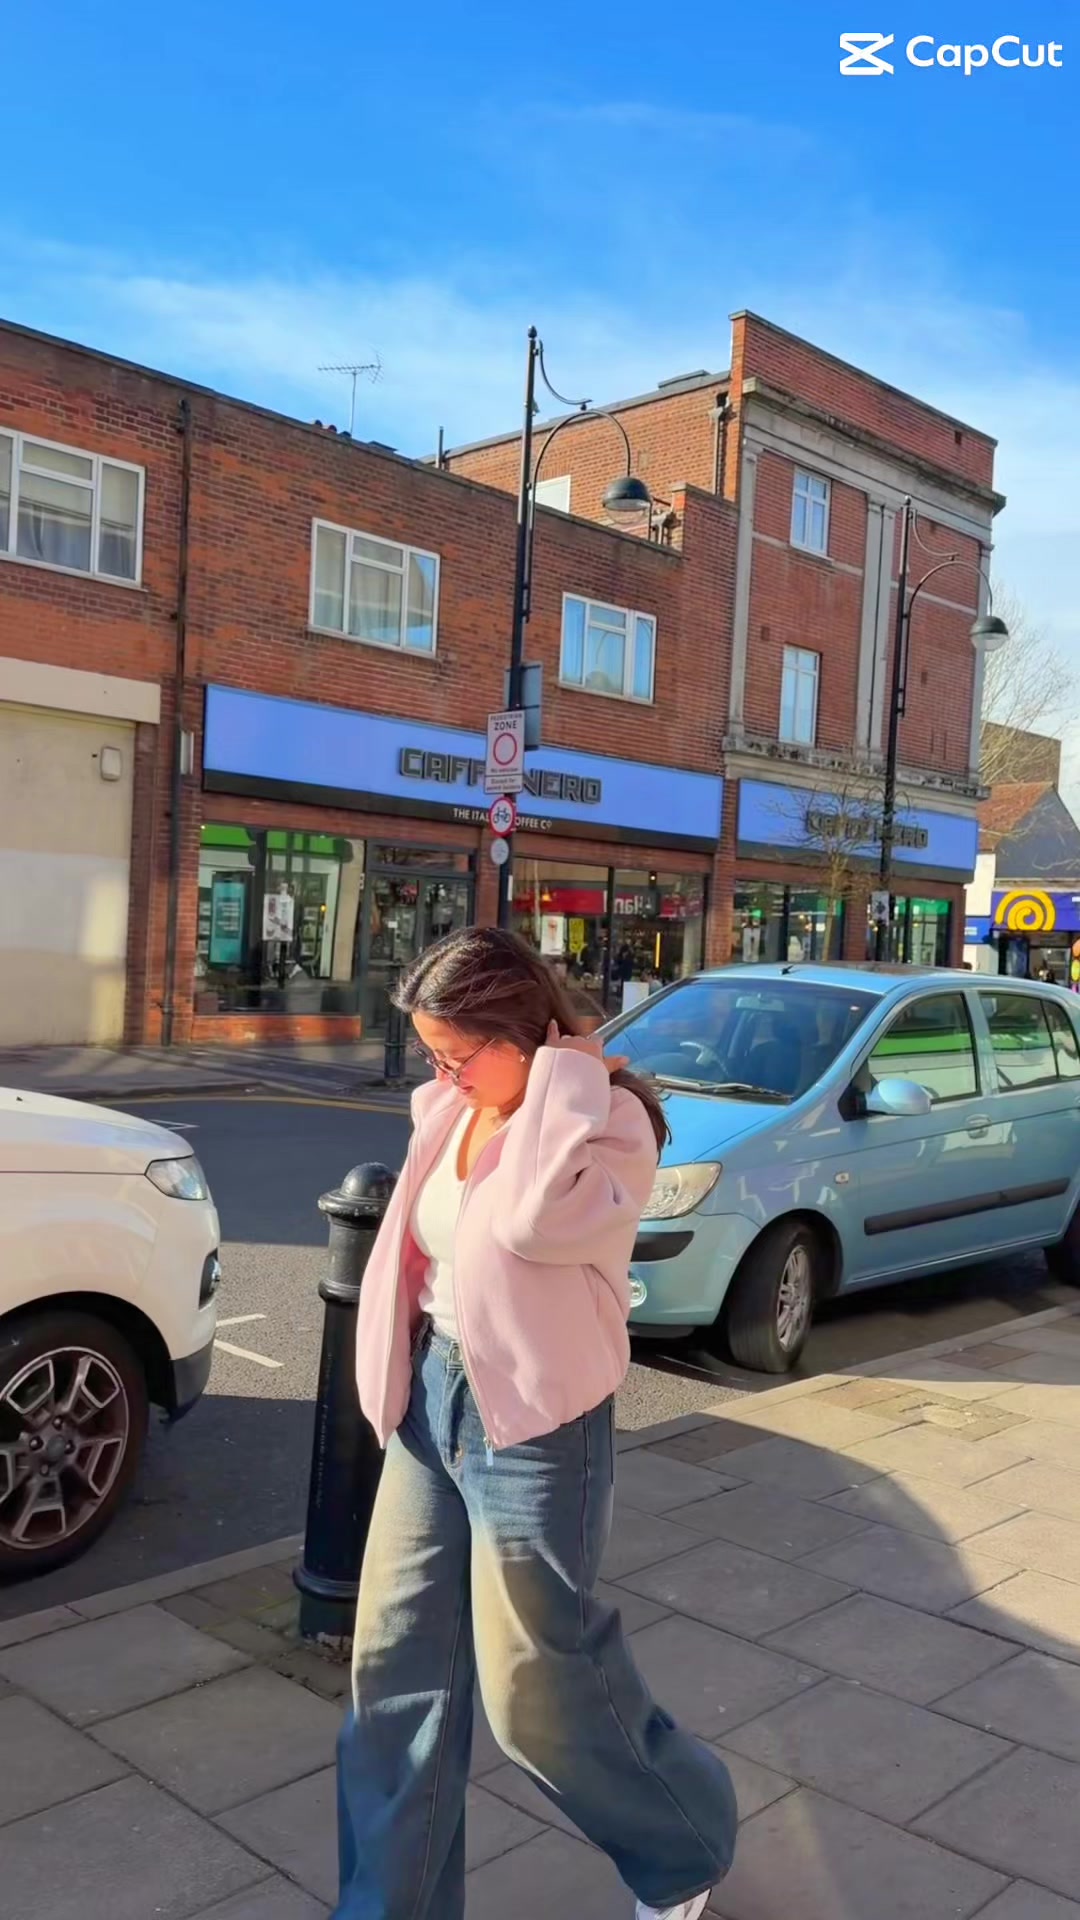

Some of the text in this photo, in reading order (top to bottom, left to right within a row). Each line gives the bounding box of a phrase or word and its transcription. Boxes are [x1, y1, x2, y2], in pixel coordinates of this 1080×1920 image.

[494, 720, 517, 731] ZONE
[399, 747, 486, 787] CAFF
[453, 808, 471, 819] THE
[514, 816, 538, 828] OFFEE
